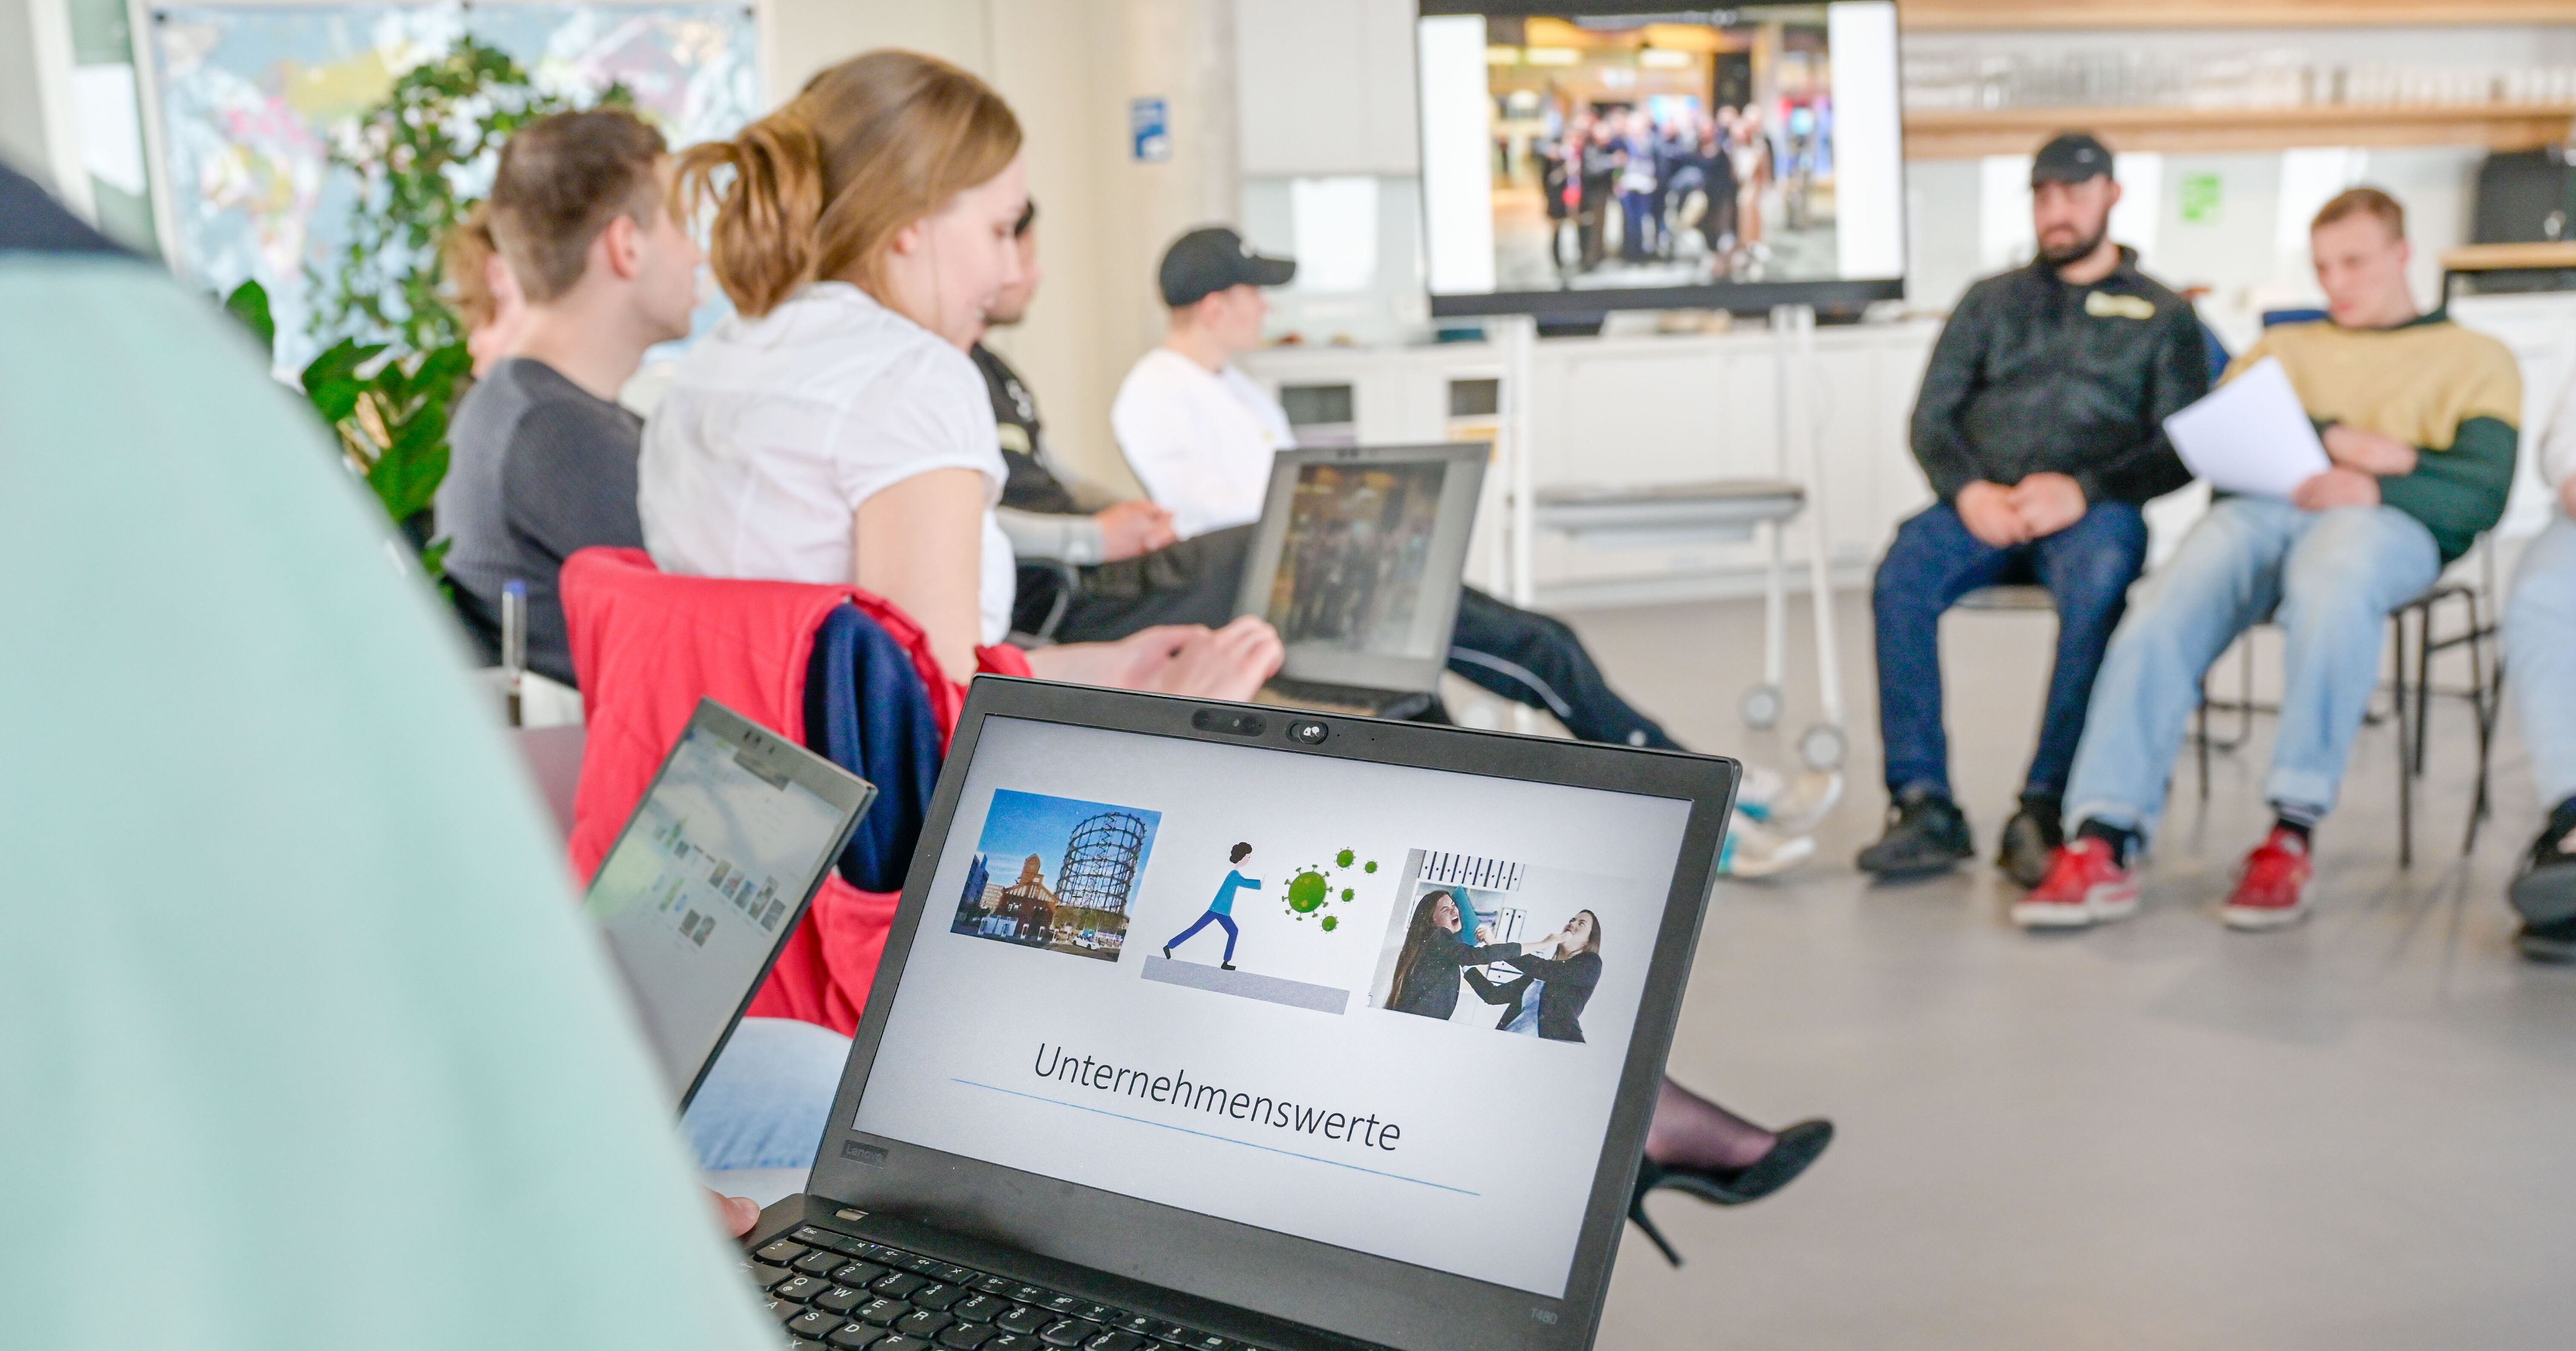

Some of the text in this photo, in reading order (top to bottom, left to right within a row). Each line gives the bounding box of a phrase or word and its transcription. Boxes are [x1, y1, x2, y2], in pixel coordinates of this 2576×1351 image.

[1034, 1043, 1401, 1152] Unternehmenswerte
[793, 1278, 808, 1286] Q
[833, 1288, 852, 1297] W
[871, 1299, 888, 1308] E
[805, 1312, 819, 1321] S
[913, 1311, 929, 1320] R
[844, 1324, 860, 1332] D
[958, 1323, 973, 1332] T
